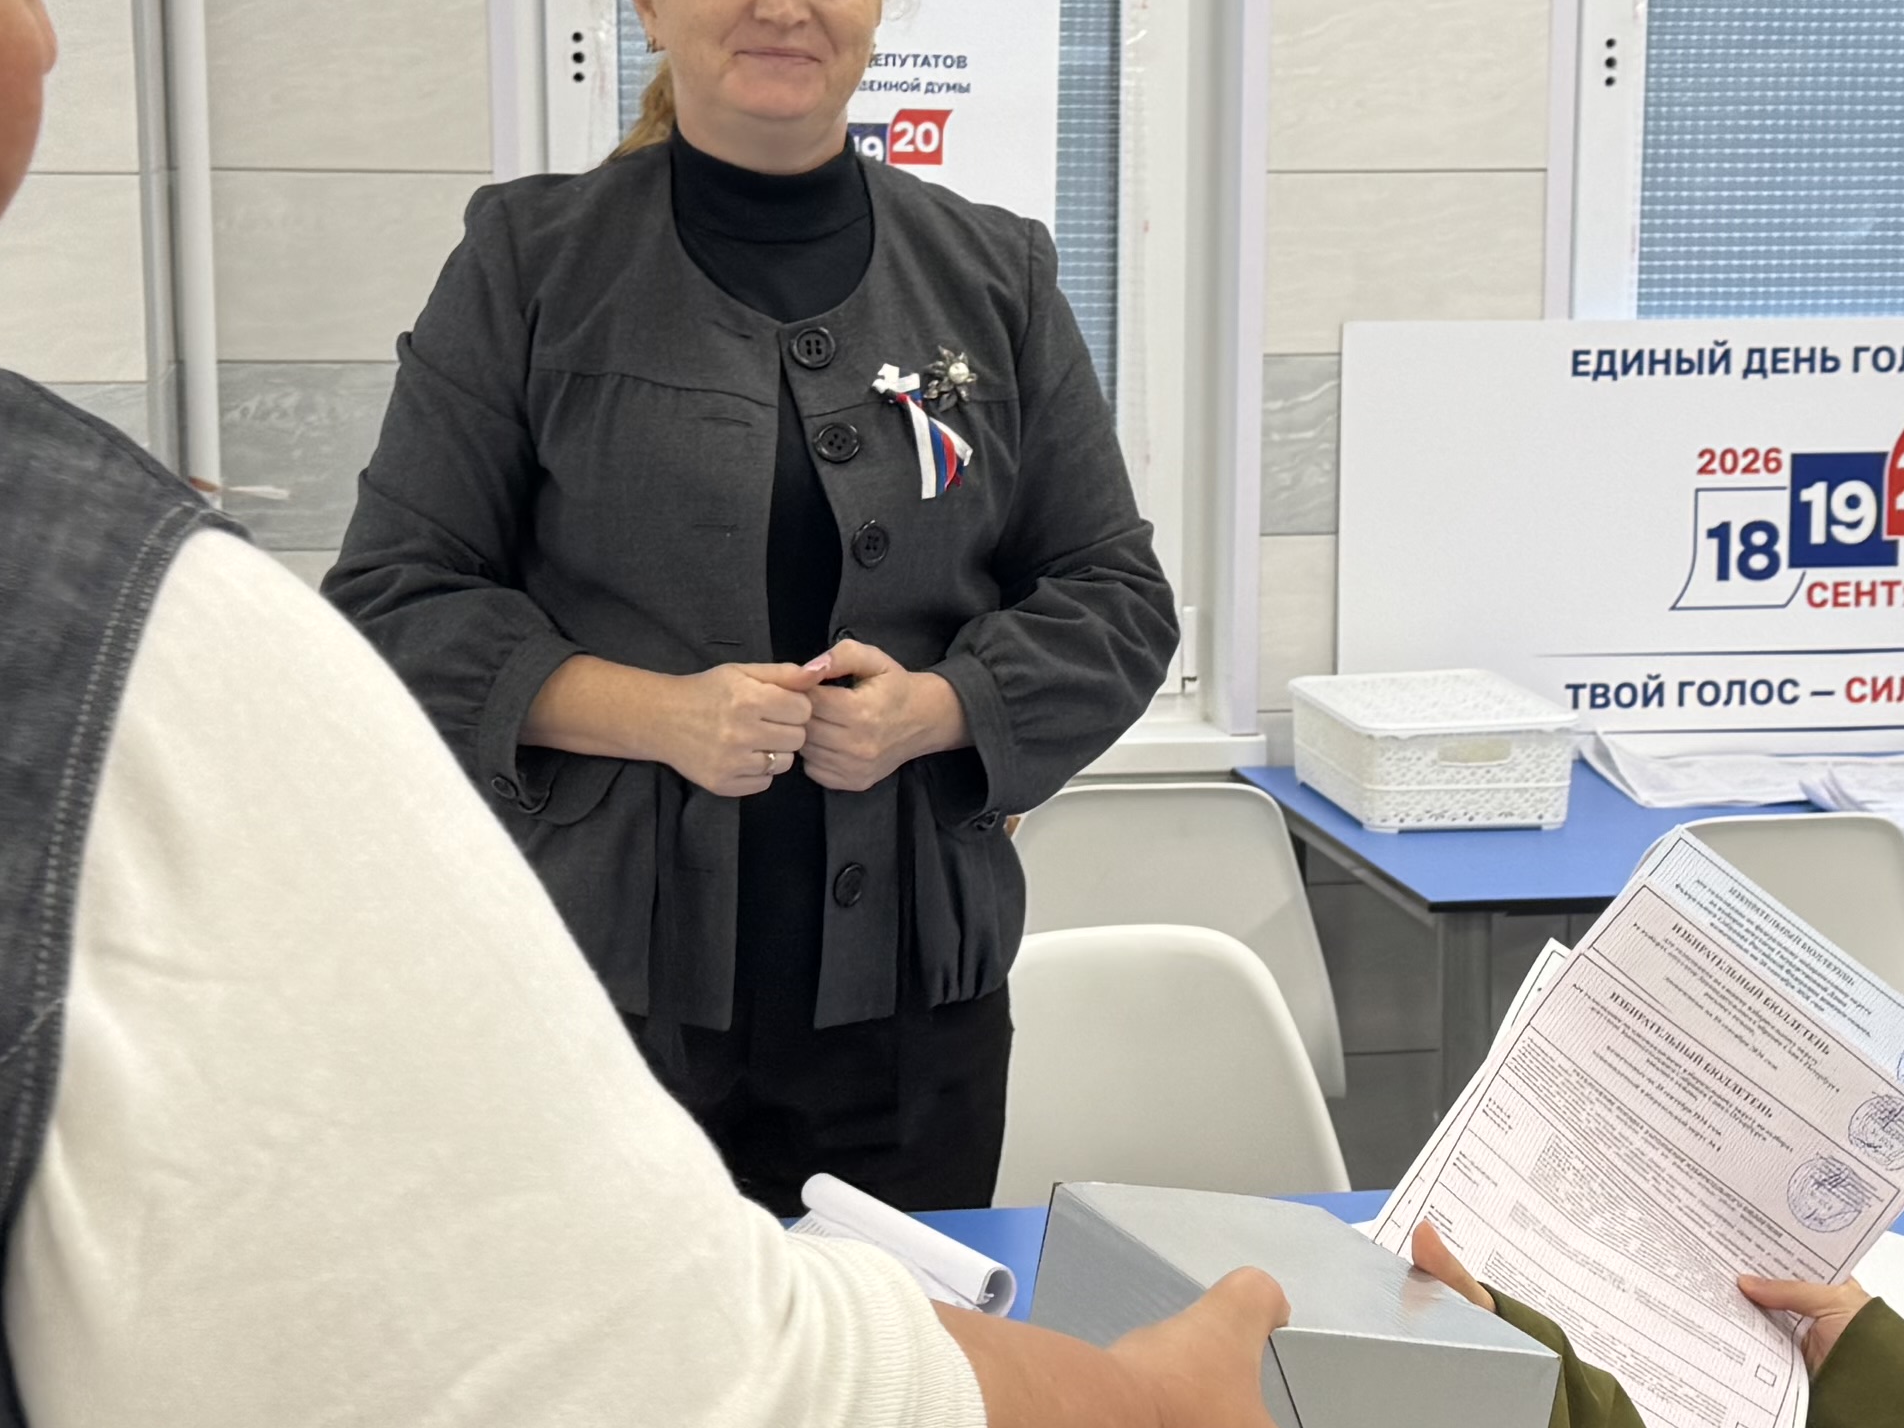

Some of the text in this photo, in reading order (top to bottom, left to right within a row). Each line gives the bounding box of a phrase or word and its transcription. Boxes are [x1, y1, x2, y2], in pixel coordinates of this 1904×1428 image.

[924, 81, 972, 94] ДУМЫ
[892, 120, 940, 153] 20
[1571, 340, 1732, 381] ЕДИНЫЙ
[1742, 345, 1840, 379] ДЕНЬ
[1697, 447, 1782, 474] 2026
[1706, 520, 1780, 581] 18
[1800, 479, 1877, 545] 19
[1566, 674, 1664, 710] ТВОЙ
[1678, 678, 1799, 708] ГОЛОС
